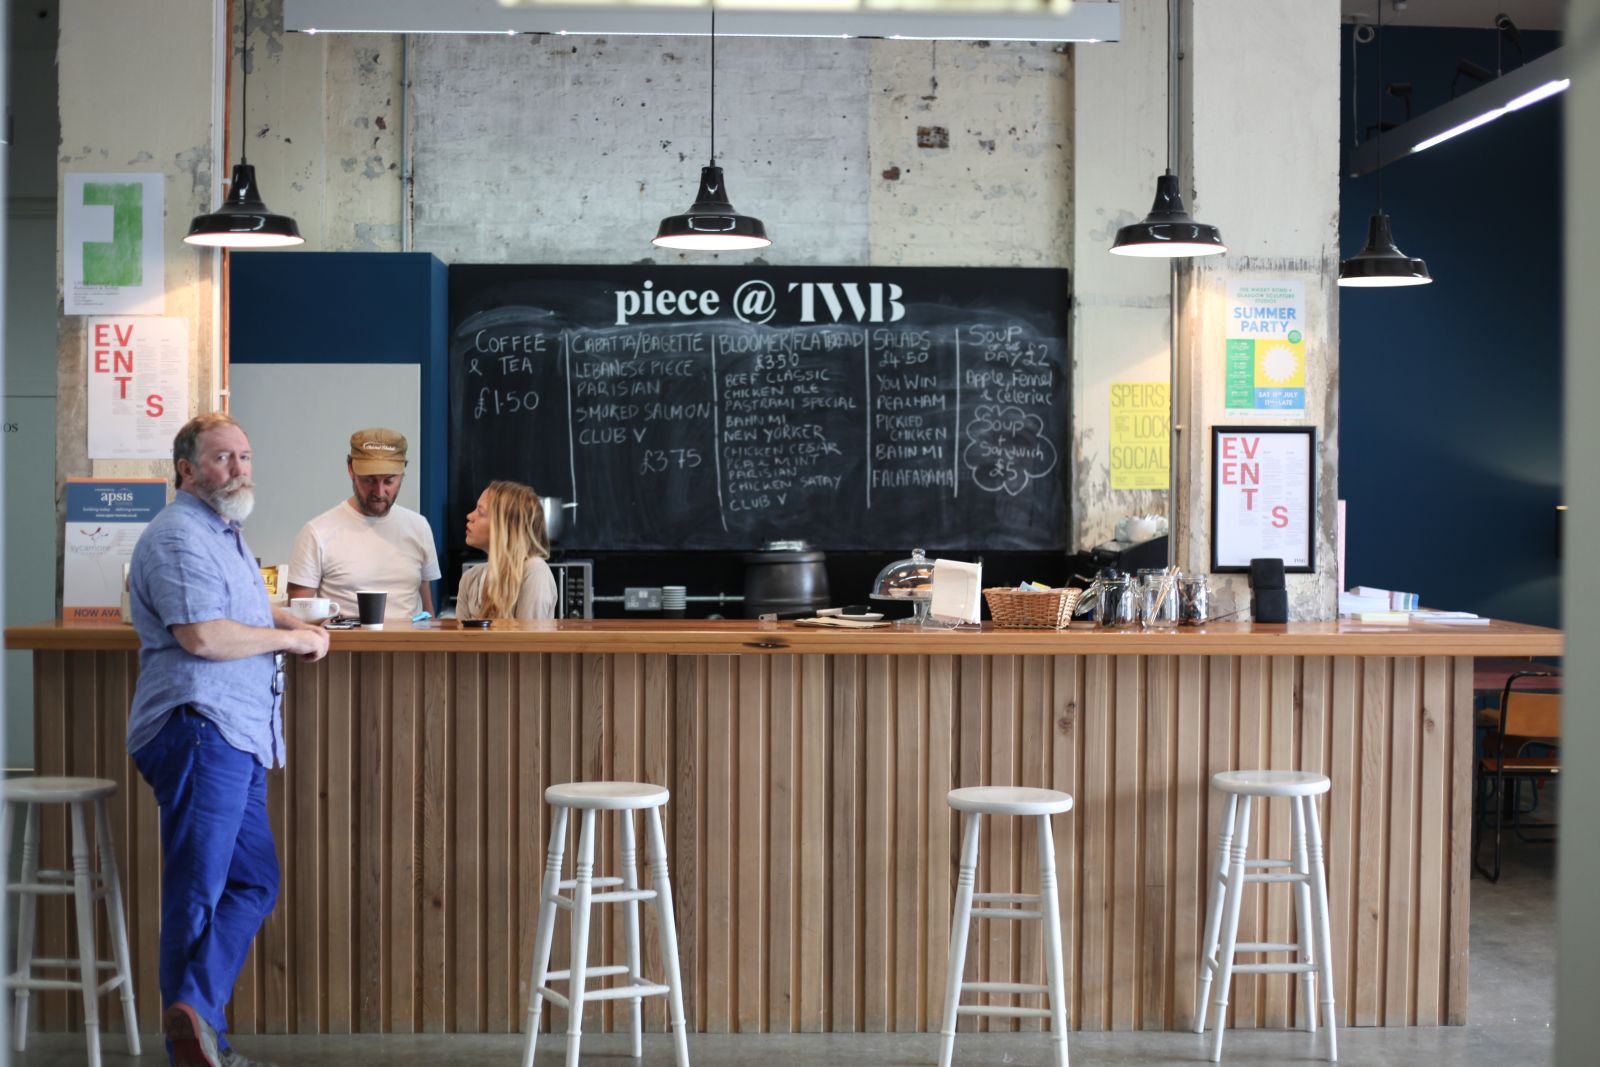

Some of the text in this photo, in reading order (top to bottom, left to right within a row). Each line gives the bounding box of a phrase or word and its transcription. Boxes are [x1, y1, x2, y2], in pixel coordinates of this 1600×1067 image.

[614, 279, 906, 326] piece @ TWB
[1233, 307, 1297, 320] SUMMER
[94, 324, 134, 347] EV
[1241, 320, 1289, 333] PARTY
[475, 329, 547, 353] COFFEE
[873, 328, 931, 351] SALADS
[94, 350, 133, 373] EN
[498, 354, 533, 375] TEA
[575, 360, 694, 380] LEBANESE PIECE
[725, 368, 830, 387] BEEF CLASSIC
[576, 380, 661, 397] PARISIAN
[723, 385, 784, 400] CHICKEN
[1111, 383, 1166, 409] SPEIRS
[575, 402, 710, 422] SMOKED SALMON
[724, 396, 857, 414] PASTRAMI SPECIAL
[768, 414, 787, 426] MI
[578, 426, 647, 445] CLUB V
[723, 424, 826, 444] NEW YORKER
[922, 444, 943, 460] MI
[1111, 446, 1168, 470] SOCIAL
[1222, 437, 1260, 460] EV
[1222, 463, 1260, 485] EN
[728, 475, 842, 494] CHICKEN SATAY
[100, 492, 133, 506] apsis
[729, 494, 771, 512] CLUB
[74, 609, 99, 617] NOW
